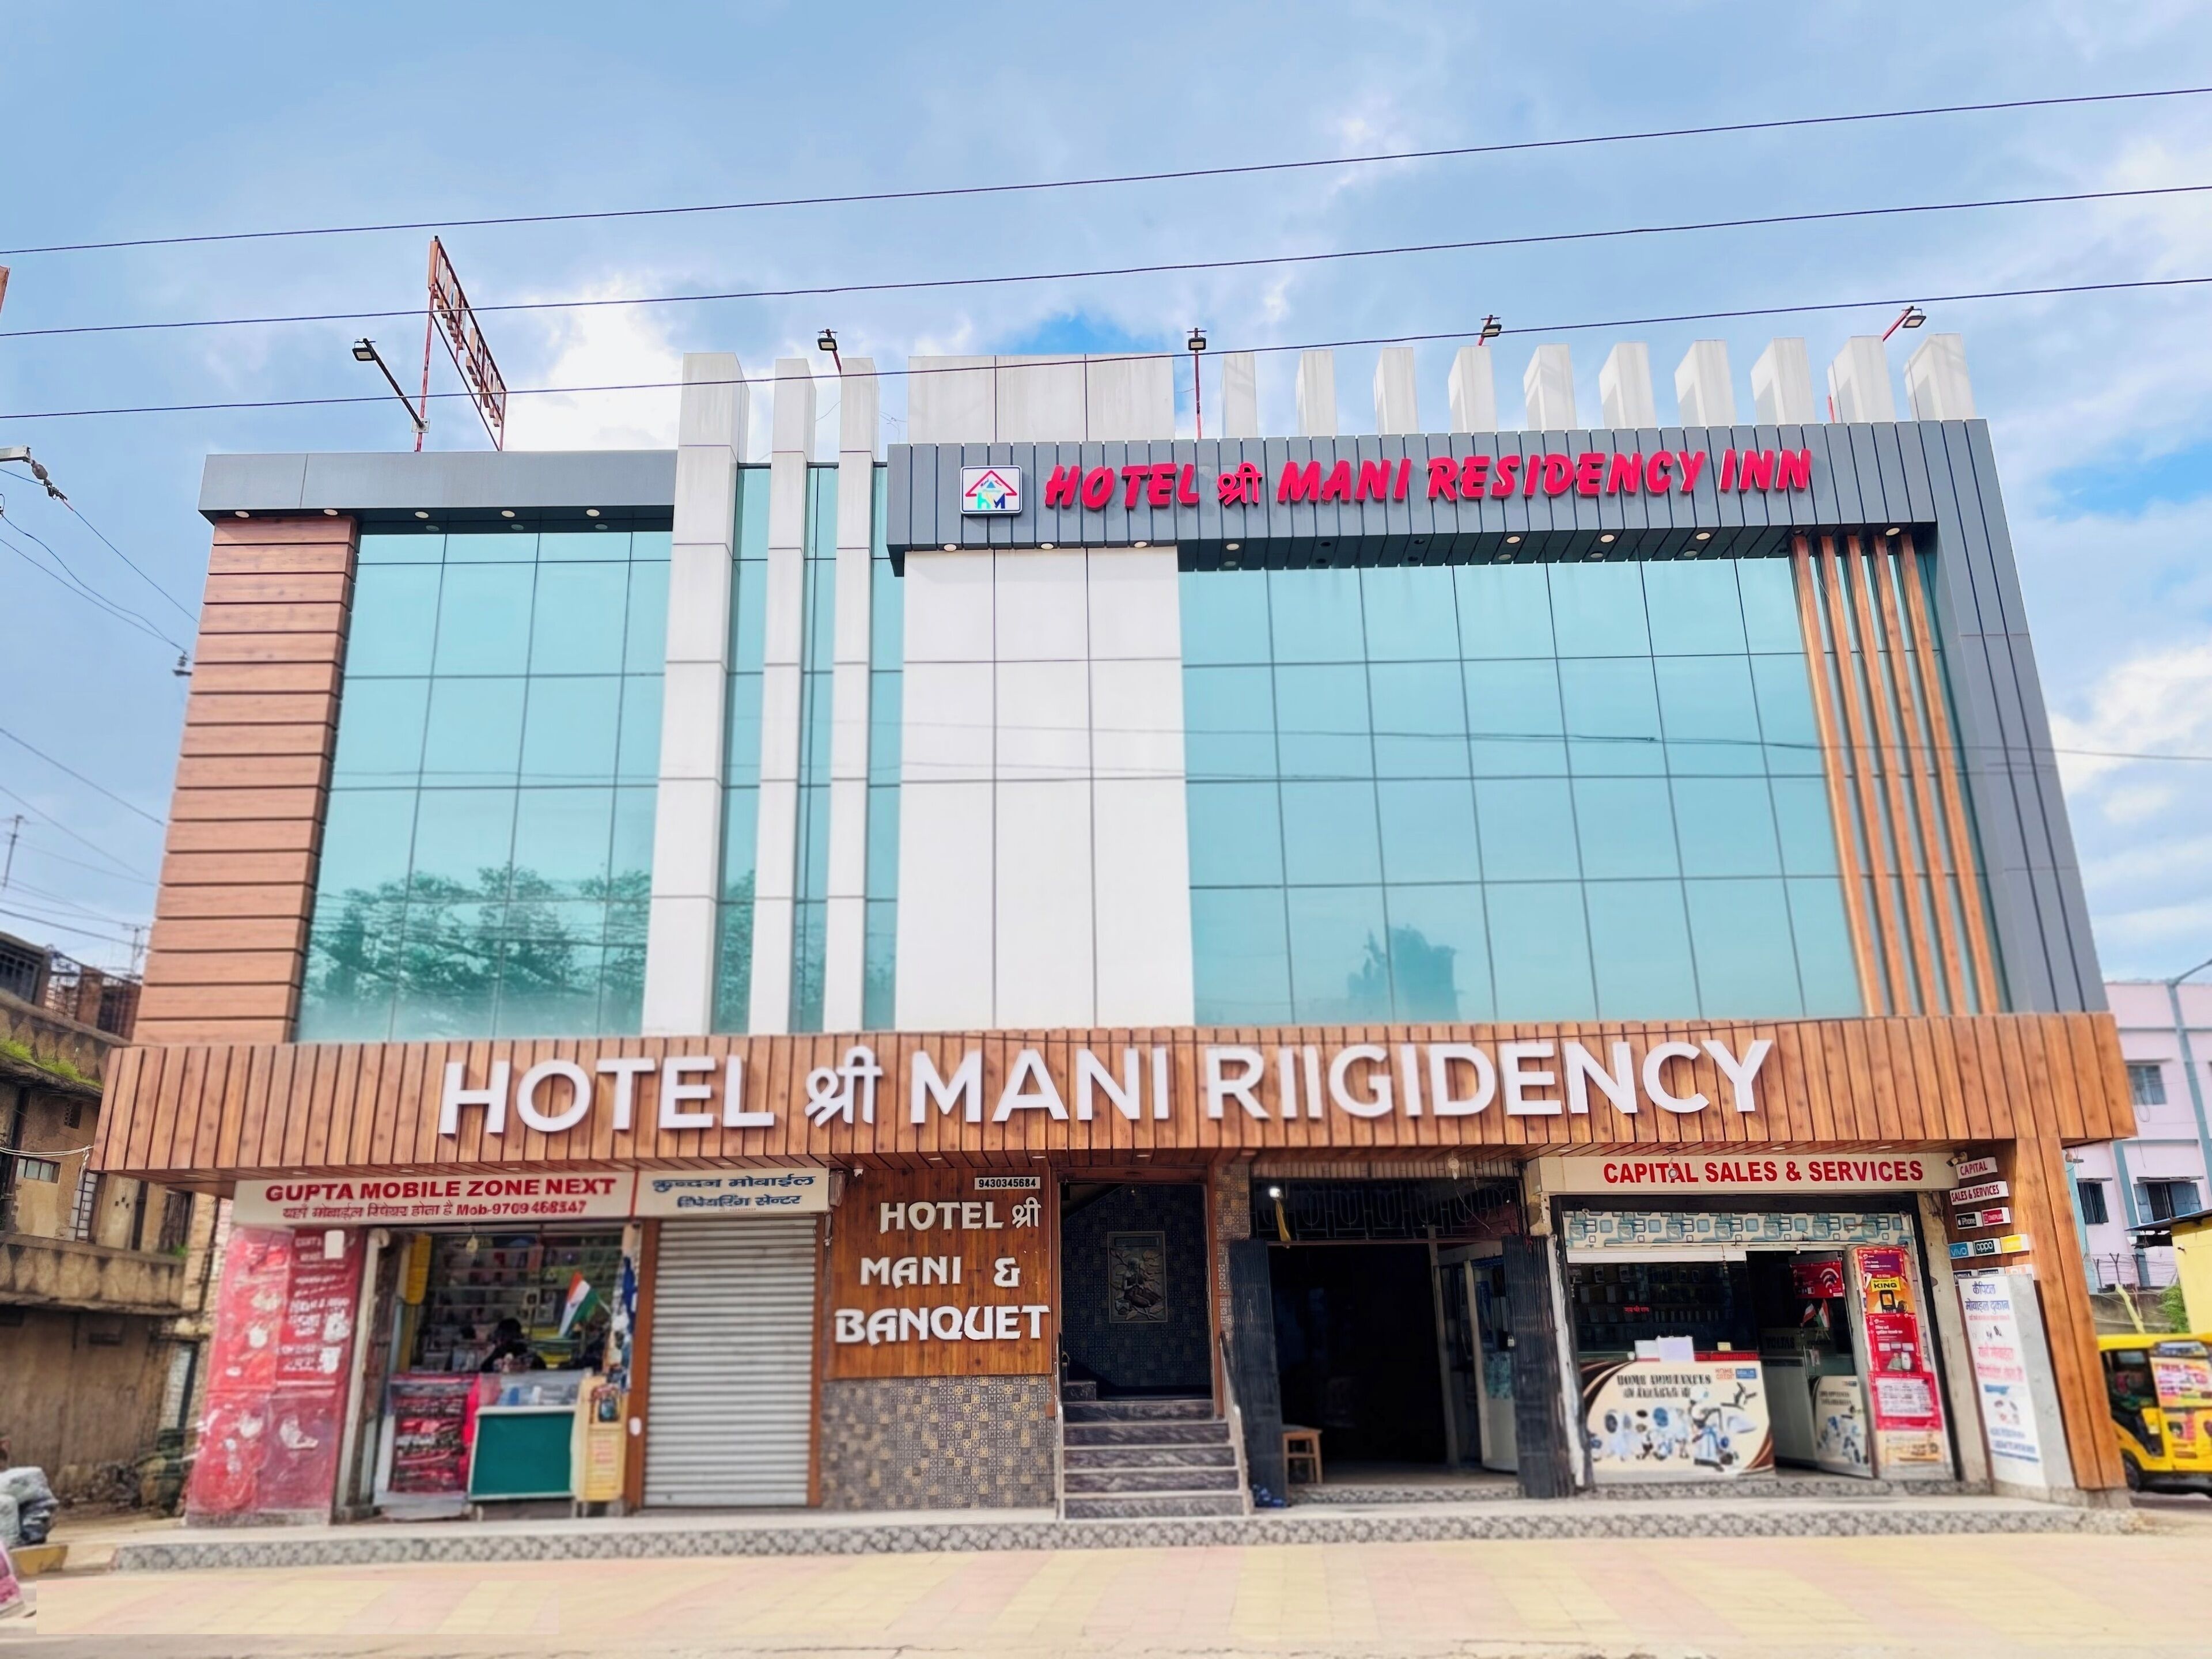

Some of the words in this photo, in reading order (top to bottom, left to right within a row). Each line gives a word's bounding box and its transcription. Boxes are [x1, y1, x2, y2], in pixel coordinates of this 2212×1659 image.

[1045, 463, 1199, 510] HOTEL
[1218, 462, 1263, 506] श्री
[1277, 459, 1411, 505] MANI
[1427, 450, 1706, 502] RESIDENCY
[1718, 449, 1812, 493] INN
[438, 1054, 774, 1134] HOTEL
[804, 1046, 883, 1127] श्री
[910, 1046, 1169, 1123] MANI
[1205, 1039, 1773, 1121] RIIGIDENCY
[729, 1173, 816, 1187] मोबाईल
[1604, 1162, 1699, 1183] CAPITAL
[1706, 1161, 1777, 1183] SALES
[1786, 1161, 1802, 1181] &
[1809, 1160, 1923, 1182] SERVICES
[1960, 1161, 1988, 1176] CAPITAL
[266, 1183, 354, 1202] GUPTA
[360, 1181, 461, 1199] MOBILE
[467, 1179, 540, 1197] ZONE
[545, 1178, 616, 1195] NEXT
[978, 1178, 1036, 1188] 9430345684
[1952, 1191, 1967, 1202] SALES
[1968, 1191, 1973, 1199] &
[1973, 1184, 1999, 1199] SERVICES
[411, 1200, 440, 1217] होता
[443, 1199, 453, 1216] है
[880, 1201, 1004, 1234] HOTEL
[1012, 1196, 1041, 1229] श्री
[860, 1256, 961, 1289] MANI
[994, 1257, 1020, 1287] &
[834, 1305, 1051, 1347] BANQUET
